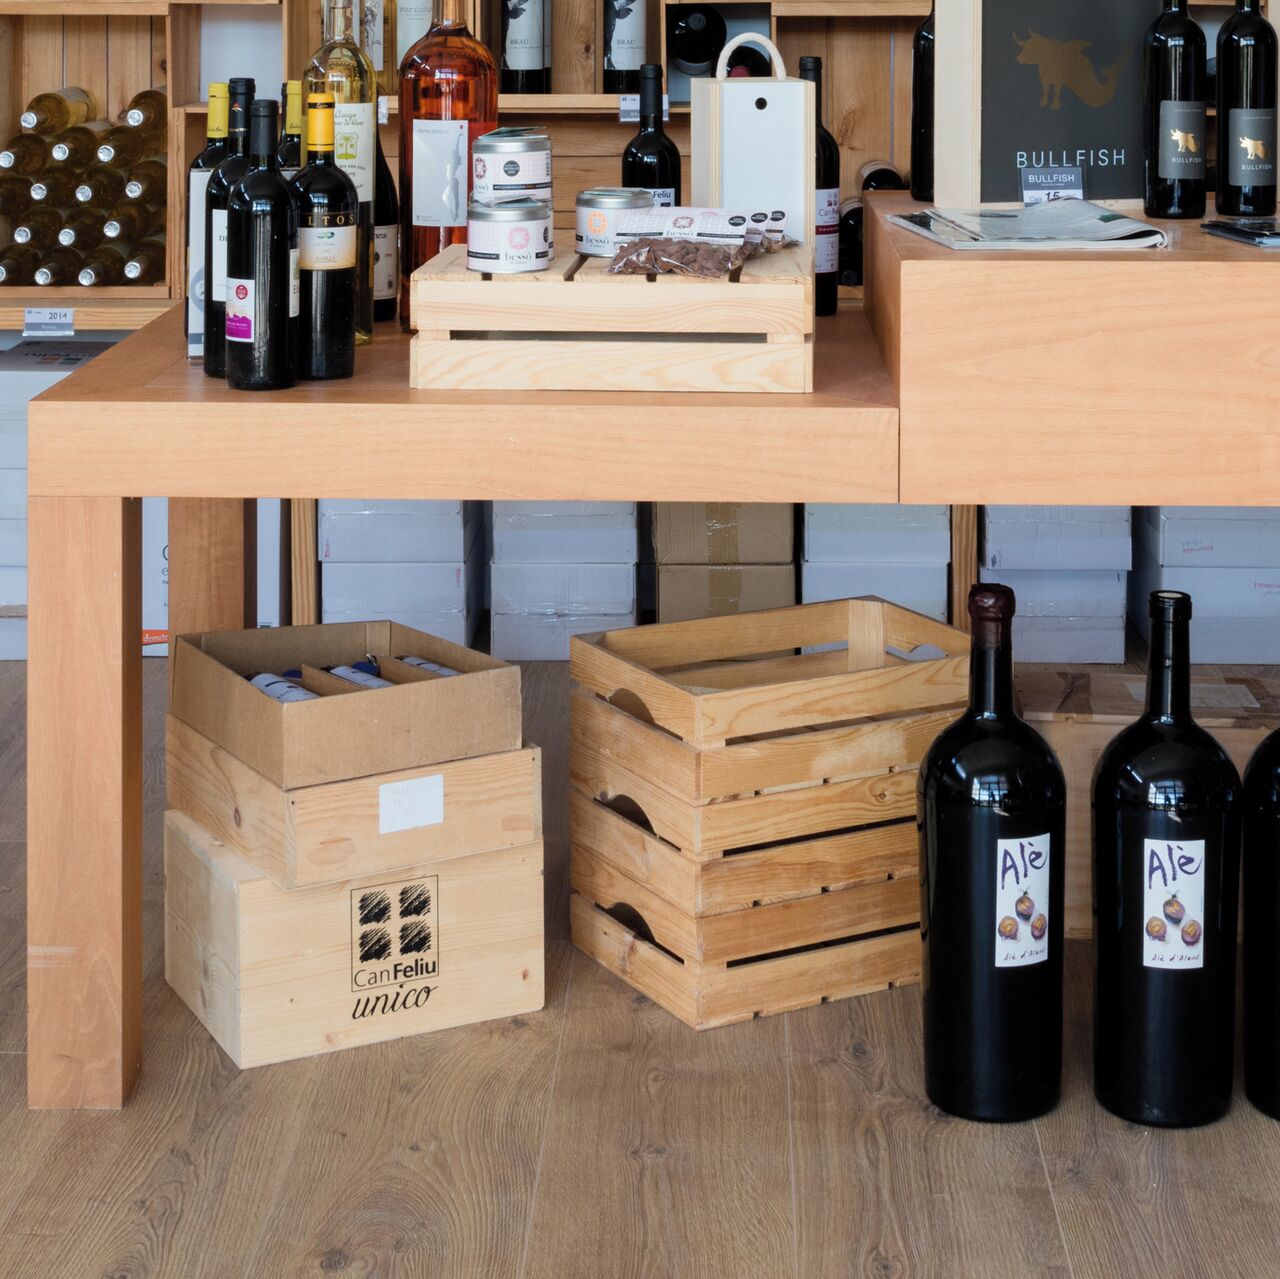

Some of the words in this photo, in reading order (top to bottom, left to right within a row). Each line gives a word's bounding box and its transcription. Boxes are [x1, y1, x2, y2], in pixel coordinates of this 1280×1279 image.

[510, 37, 529, 45] BRAU
[616, 37, 636, 45] BRAU
[1017, 149, 1126, 169] BULLFISH
[1028, 173, 1076, 184] BULLFISH
[653, 190, 671, 199] Feliu
[48, 311, 68, 320] 2014
[1000, 841, 1050, 890] Alè
[1149, 843, 1204, 890] Alè
[351, 982, 439, 1020] unico
